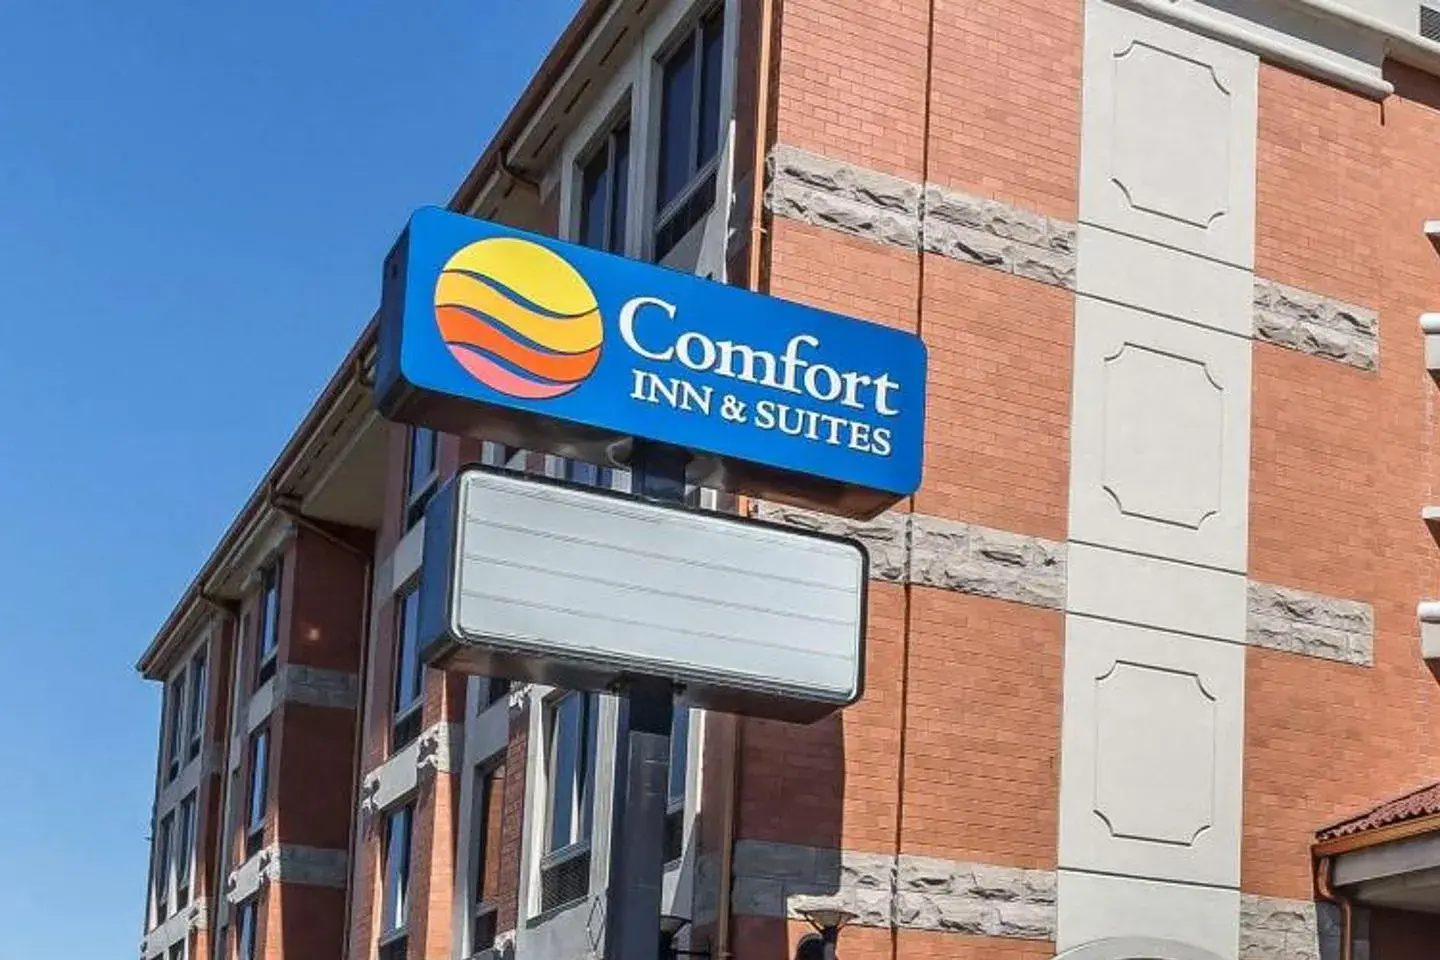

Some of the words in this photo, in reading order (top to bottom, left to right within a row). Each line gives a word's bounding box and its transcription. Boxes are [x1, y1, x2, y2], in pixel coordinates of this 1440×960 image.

[619, 296, 900, 417] Comfort
[630, 368, 714, 416] INN
[720, 394, 747, 424] &
[754, 400, 892, 457] SUITES
